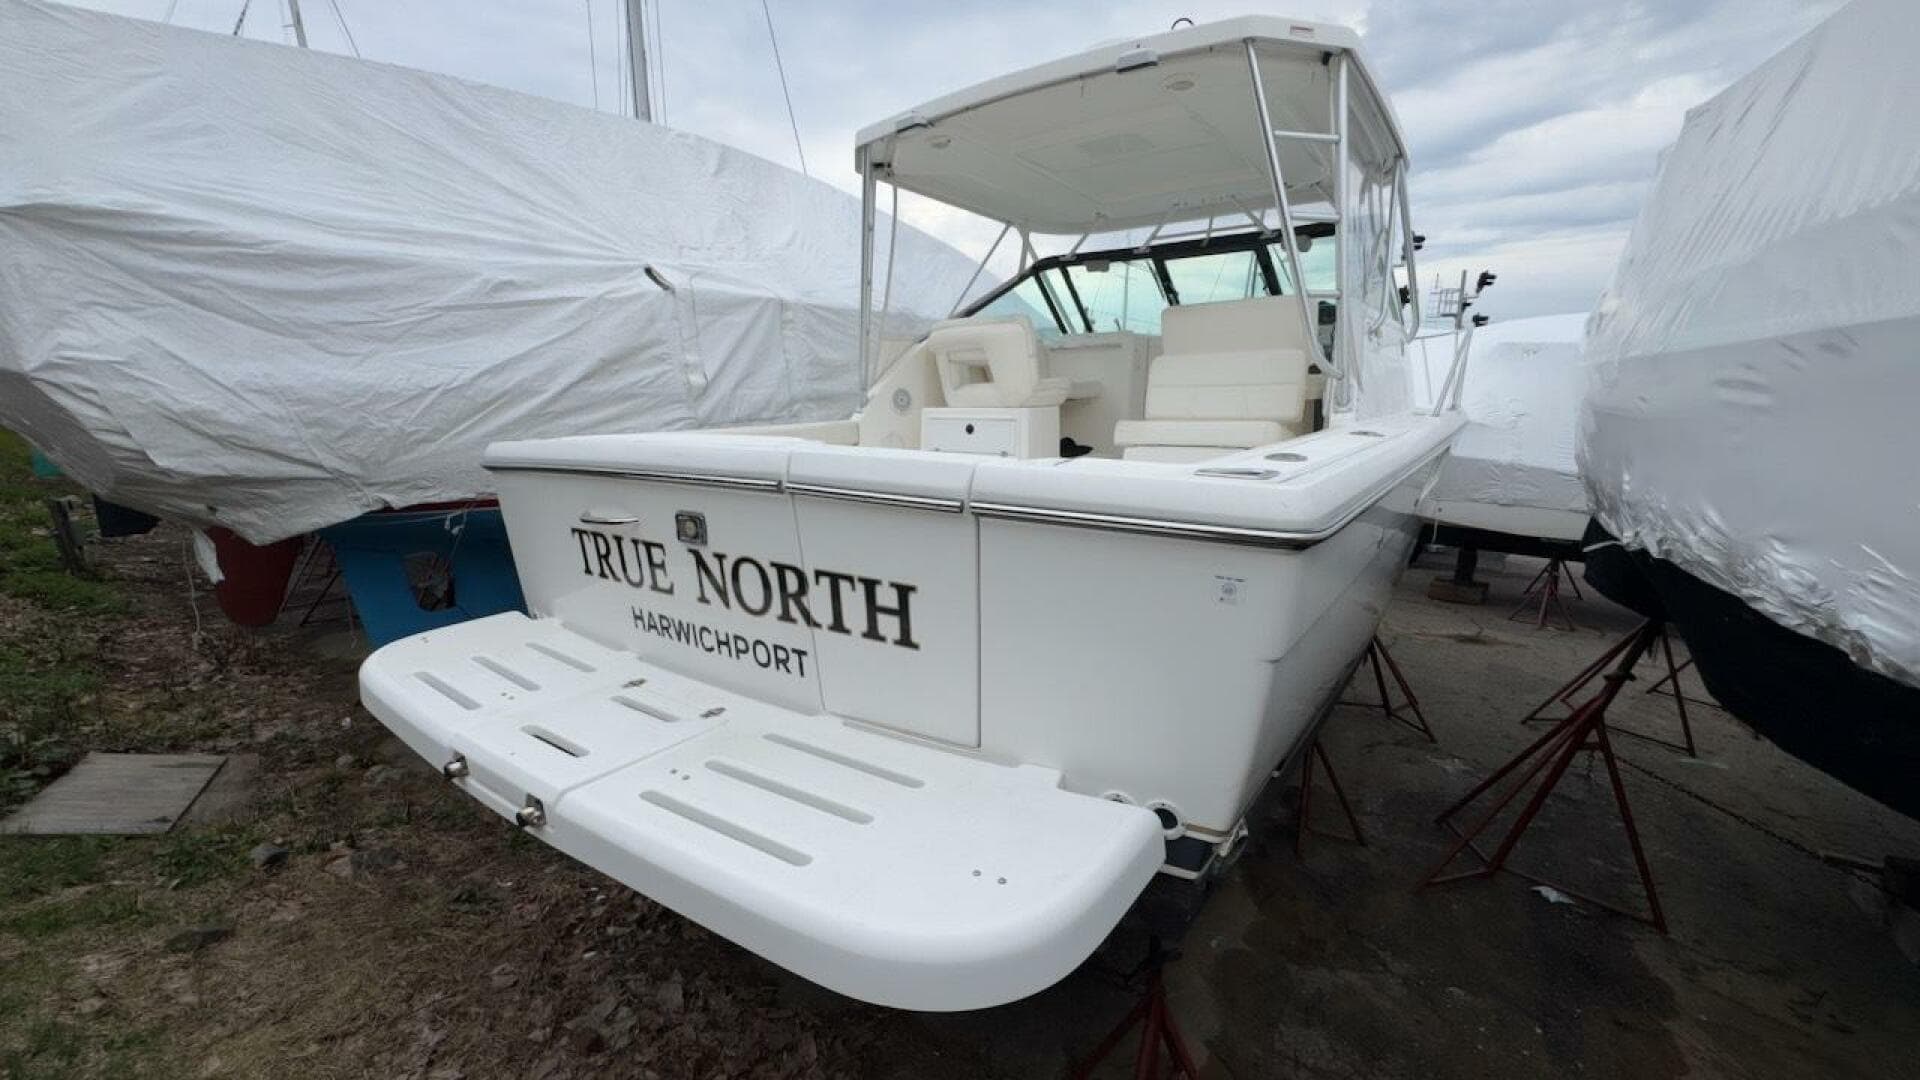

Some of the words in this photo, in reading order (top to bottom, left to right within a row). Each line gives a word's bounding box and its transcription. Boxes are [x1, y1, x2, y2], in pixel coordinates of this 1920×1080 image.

[571, 528, 674, 595] TRUE
[688, 549, 920, 650] NORTH
[632, 607, 808, 677] HARWICHPORT
